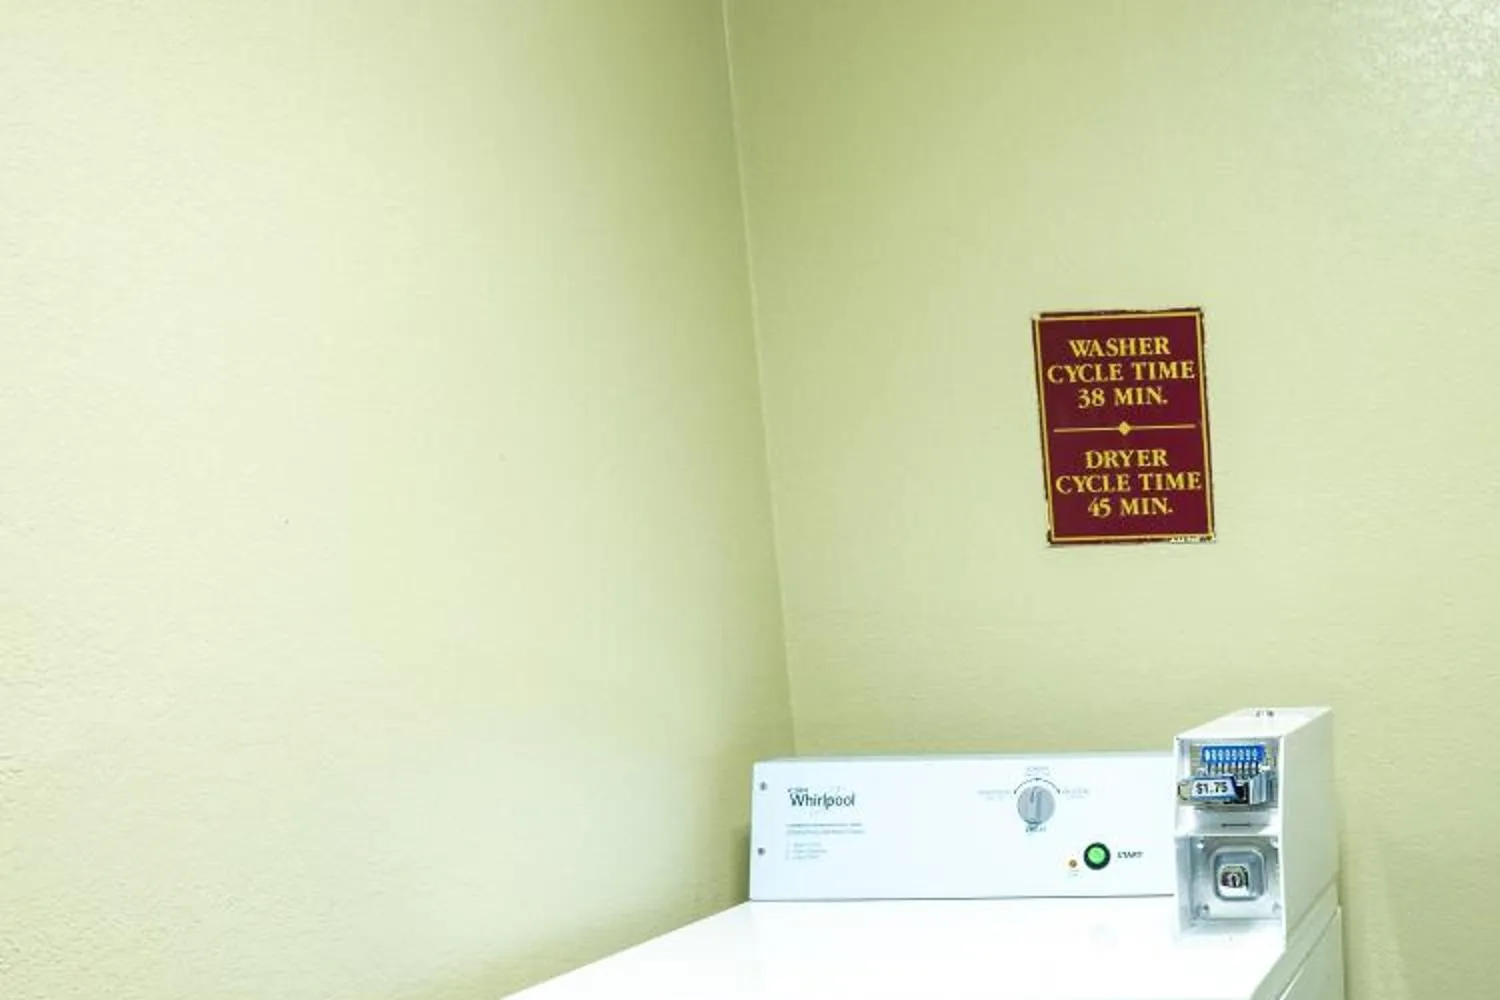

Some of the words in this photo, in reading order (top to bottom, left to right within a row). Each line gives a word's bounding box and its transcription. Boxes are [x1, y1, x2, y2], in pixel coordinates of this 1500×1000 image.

[1067, 335, 1171, 358] WASHER
[1047, 363, 1124, 384] CYCLE
[1131, 360, 1195, 380] TIME
[1078, 388, 1106, 409] 38
[1114, 385, 1168, 407] MIN.
[1085, 449, 1169, 470] DRYER
[1055, 473, 1131, 495] CYCLE
[1137, 471, 1202, 491] TIME
[1088, 498, 1112, 518] 45
[1119, 497, 1173, 517] MIN.
[1195, 781, 1228, 795] $1.75
[789, 791, 856, 811] Whirlpool
